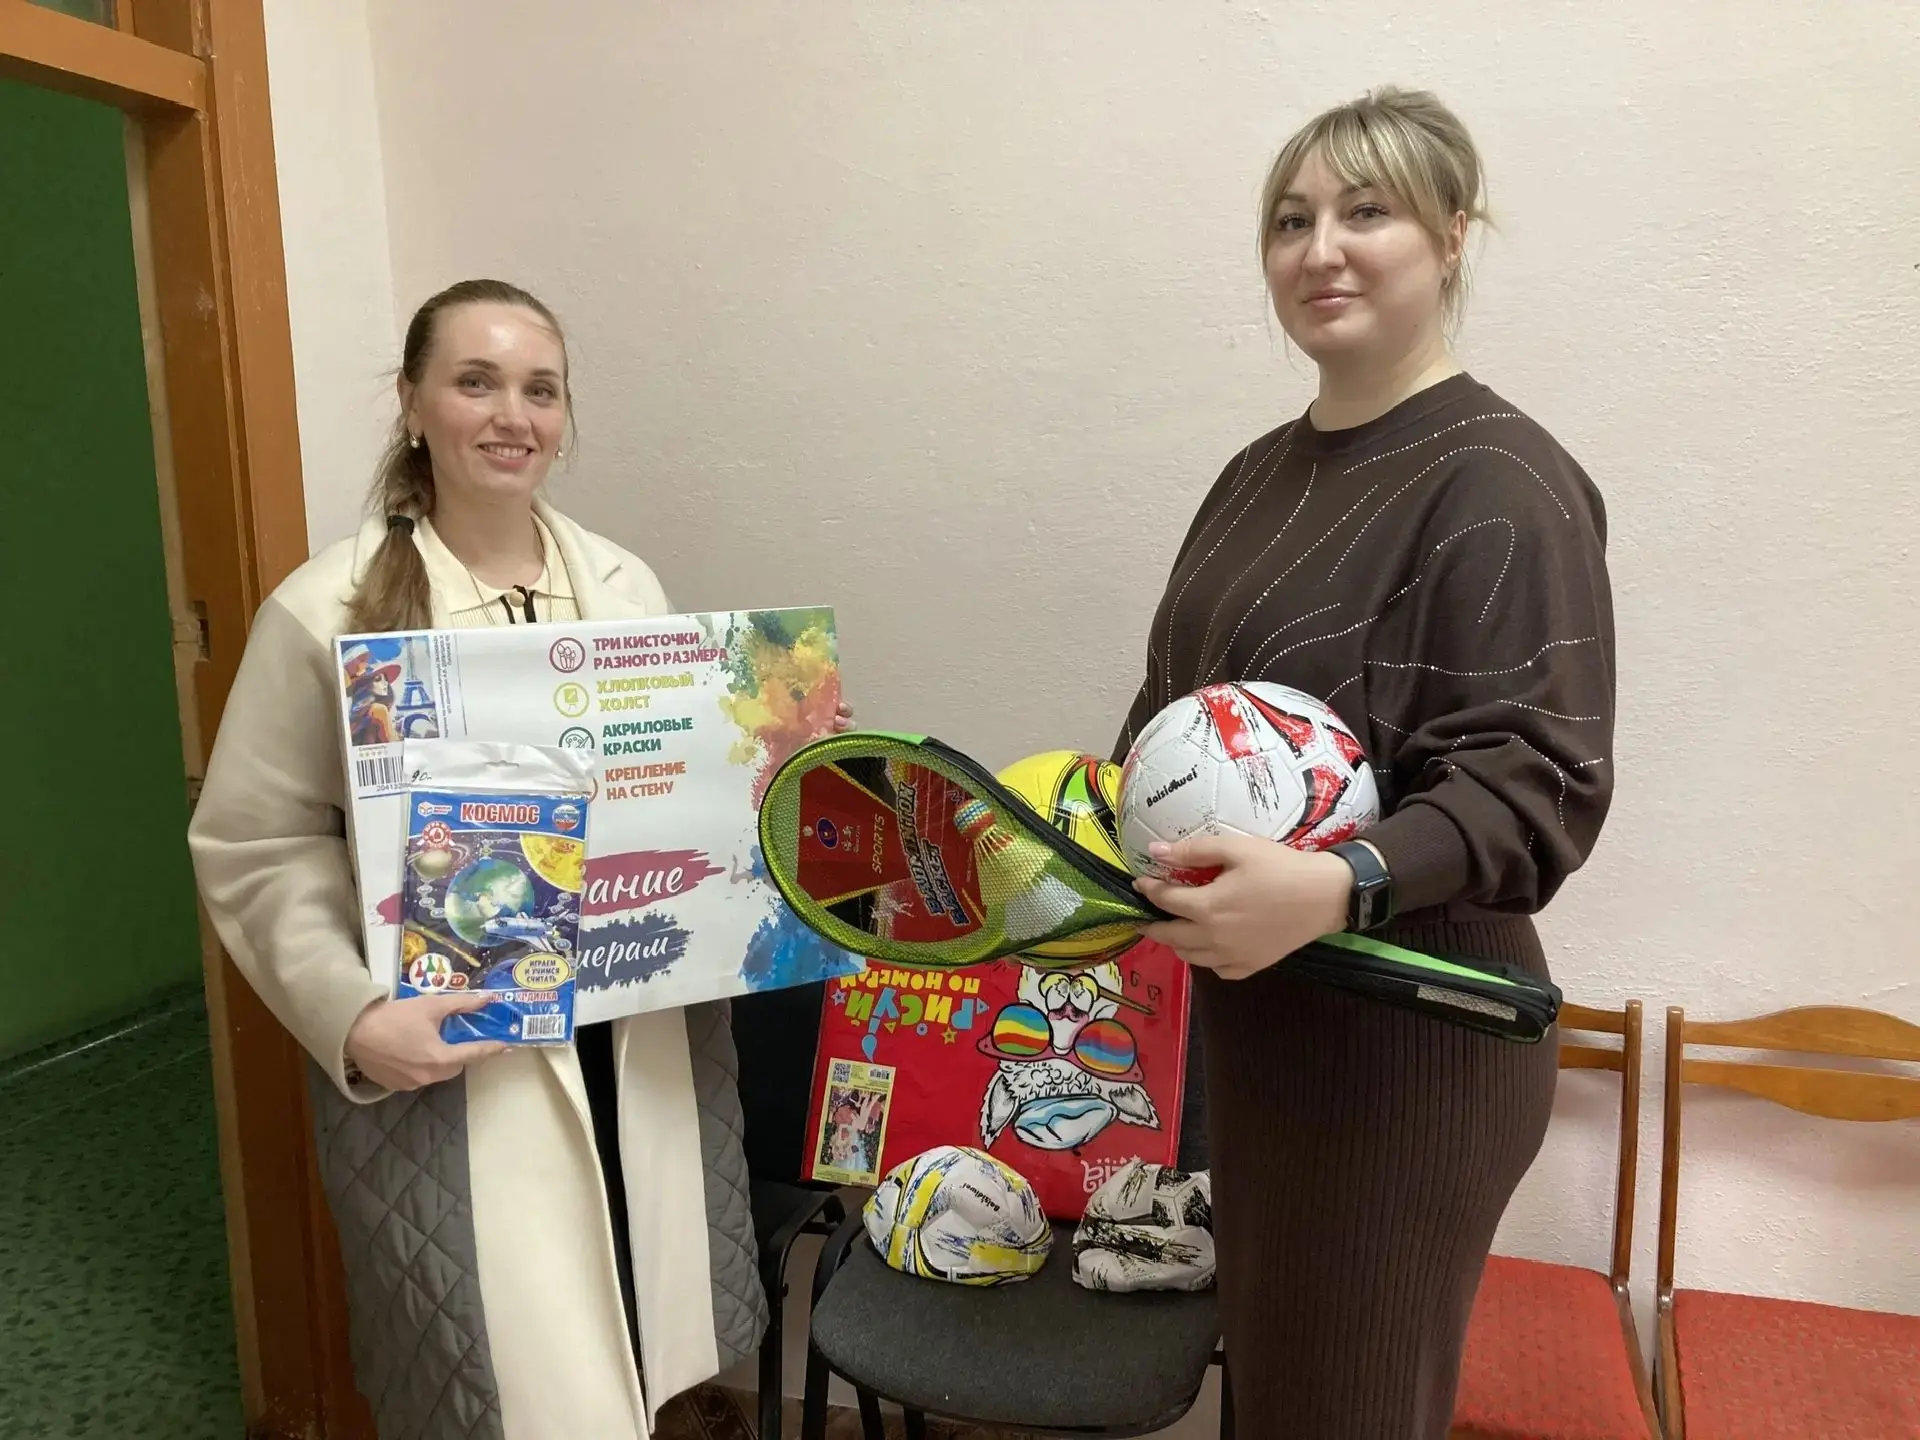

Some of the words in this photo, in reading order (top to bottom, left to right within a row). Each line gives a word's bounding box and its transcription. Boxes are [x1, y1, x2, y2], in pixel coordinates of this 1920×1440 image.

[593, 637, 621, 651] ТРИ
[623, 632, 700, 650] КИСТОЧКИ
[593, 653, 661, 670] РАЗНОГО
[663, 648, 729, 664] РАЗМЕРА
[596, 672, 694, 693] ХЛОПКОВЫЙ
[600, 696, 650, 711] ХОЛСТ
[603, 718, 693, 737] АКРИЛОВЫЕ
[603, 739, 662, 756] КРАСКИ
[605, 761, 686, 782] КРЕПЛЕНИЕ
[606, 786, 627, 800] НА
[630, 781, 674, 798] СТЕНУ
[461, 803, 540, 824] КОСМОС
[871, 813, 886, 875] SPORTS
[896, 780, 946, 916] BADMINTON
[581, 864, 683, 905] ание
[529, 960, 556, 968] ИГРАЕМ
[531, 967, 560, 975] УЧИМСЯ
[451, 977, 464, 985] 27
[526, 976, 557, 984] СЧИТАТЬ
[840, 967, 943, 991] НОМЕРАМ
[948, 974, 980, 994] ПО
[845, 987, 974, 1036] РИСУЙ
